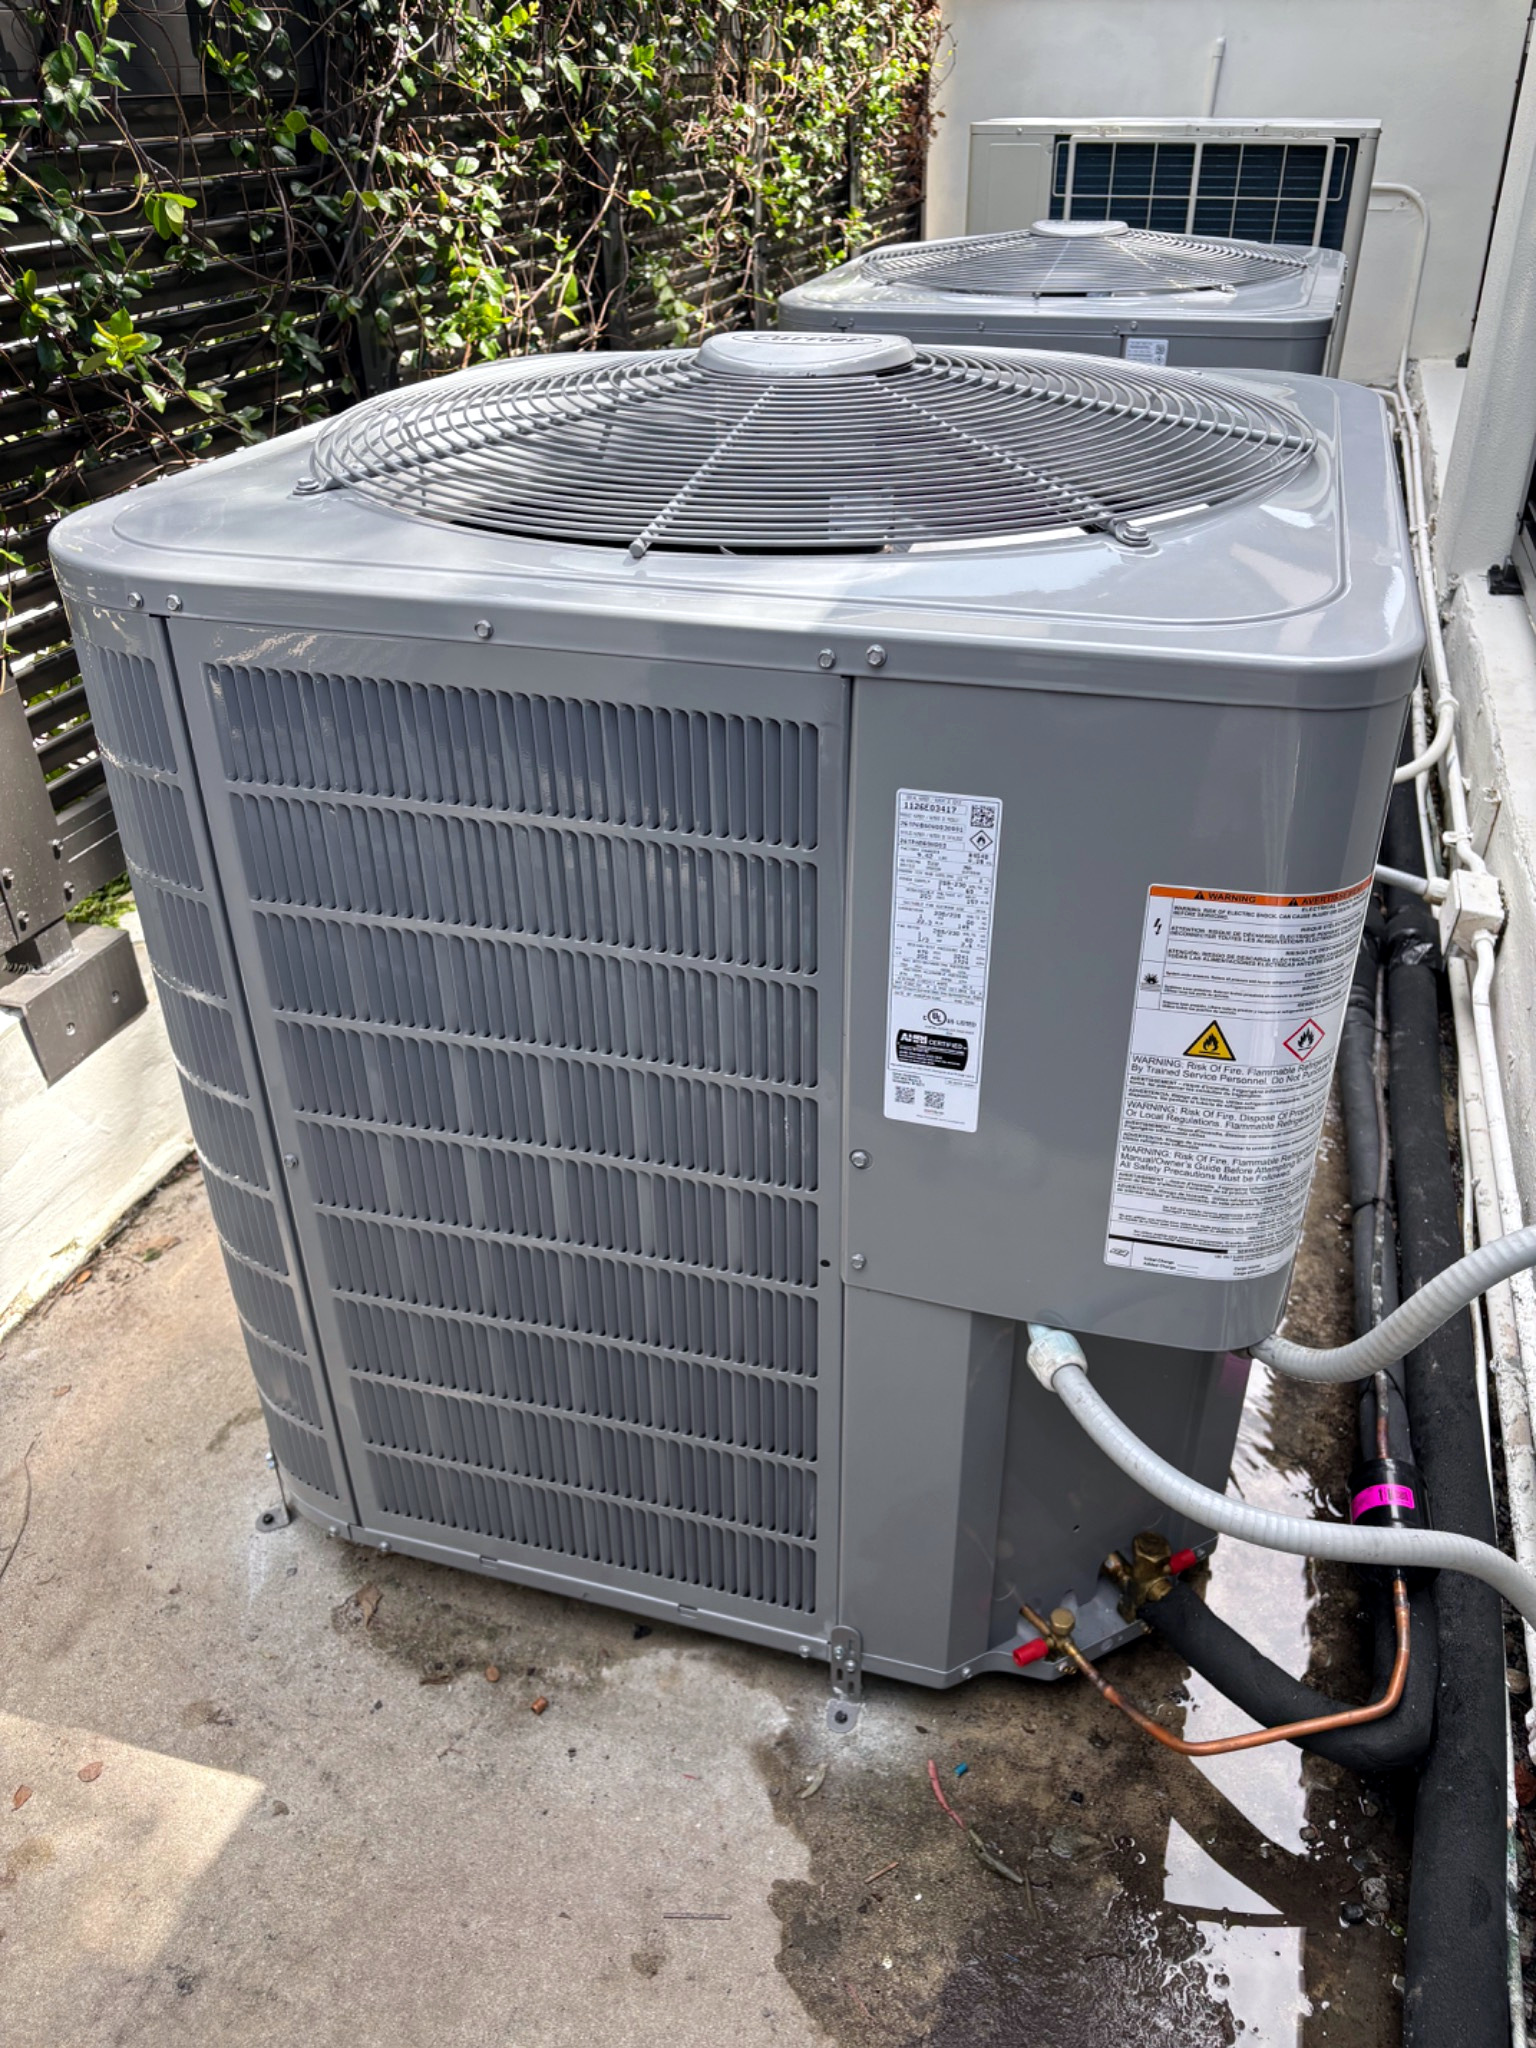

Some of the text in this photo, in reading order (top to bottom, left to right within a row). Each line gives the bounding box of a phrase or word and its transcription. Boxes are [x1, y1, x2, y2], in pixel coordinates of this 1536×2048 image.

[754, 334, 864, 343] Carrier
[1209, 892, 1256, 903] WARNING
[929, 1040, 963, 1050] CERTIFIED
[1131, 1063, 1143, 1073] By
[1146, 1065, 1180, 1077] Trained
[1183, 1070, 1217, 1081] Service
[1272, 1076, 1284, 1084] Do
[1286, 1074, 1301, 1082] Not
[1187, 1062, 1206, 1070] Risk
[1210, 1064, 1221, 1072] Of
[1224, 1066, 1243, 1075] Fire.
[1247, 1067, 1295, 1076] Flammable
[1139, 1111, 1164, 1120] Local
[1225, 1122, 1275, 1130] Flammable
[1181, 1107, 1200, 1115] Risk
[1203, 1110, 1214, 1118] Of
[1217, 1112, 1237, 1120] Fire.
[1240, 1114, 1276, 1122] Dispose
[1277, 1110, 1288, 1120] Of
[1121, 1153, 1296, 1174] Manual/Owner's Guide Before Attempting
[1174, 1152, 1193, 1160] Risk
[1209, 1156, 1229, 1165] Fire.
[1232, 1158, 1279, 1166] Flammable
[1133, 1162, 1161, 1174] Safety
[1164, 1167, 1215, 1180] Precautions
[1242, 1174, 1254, 1182] be
